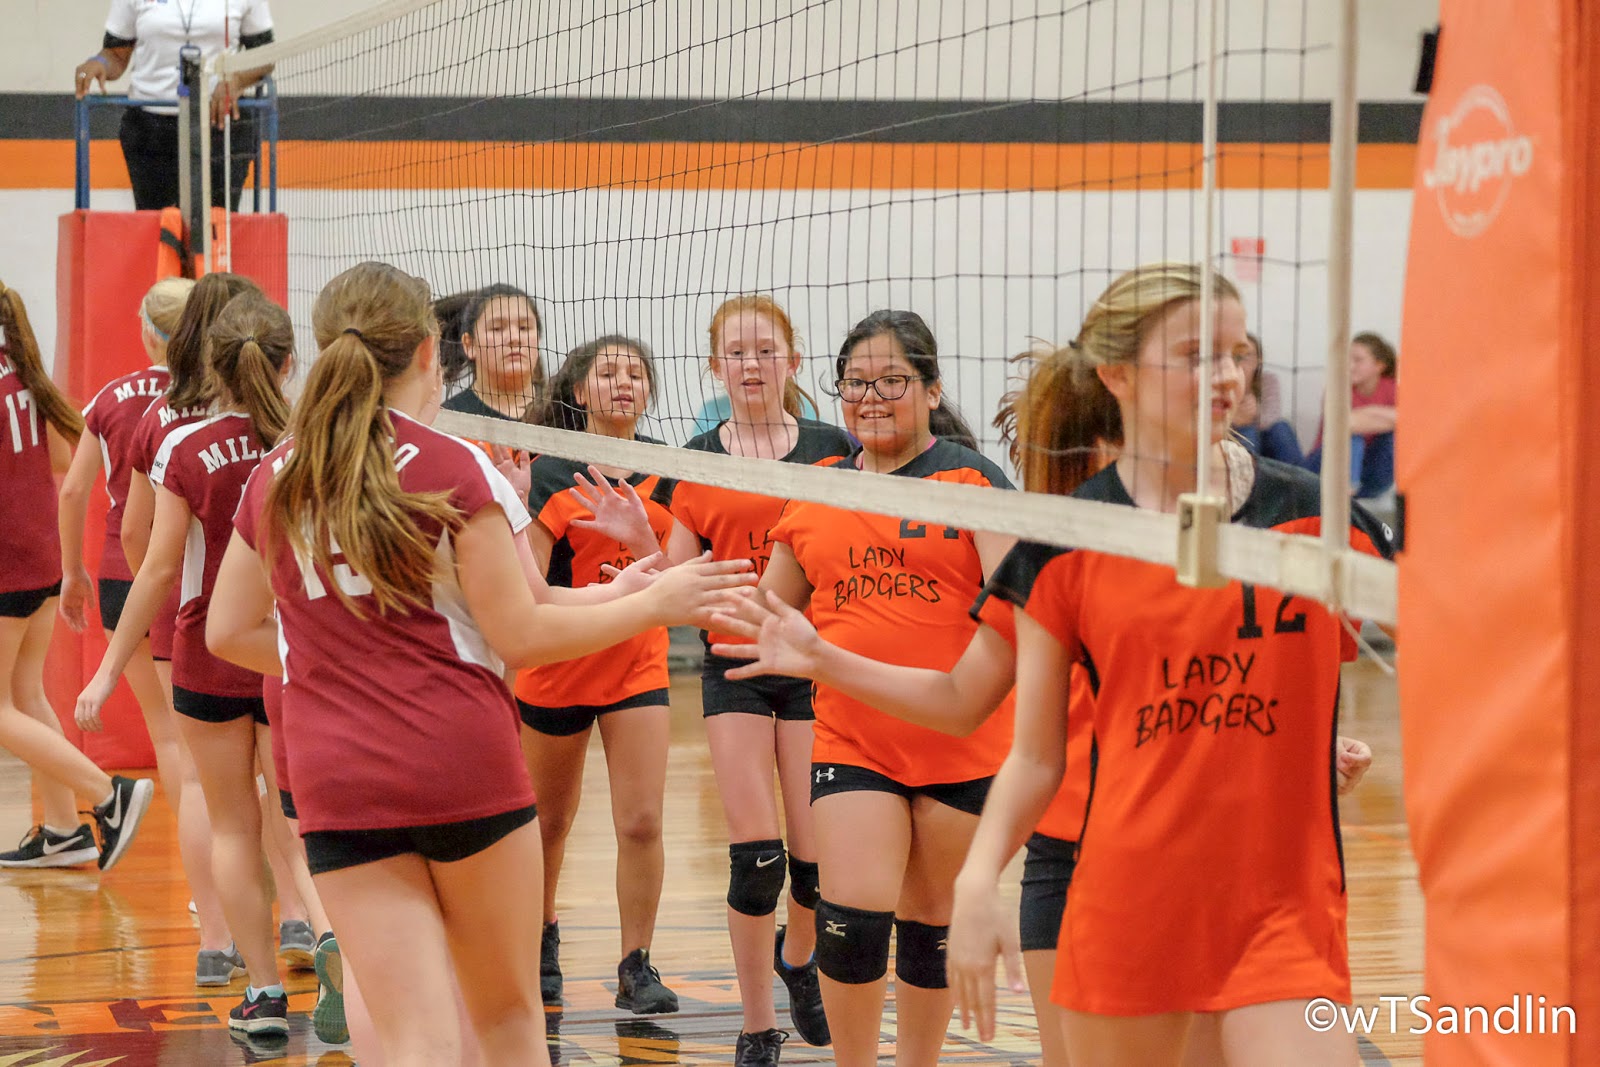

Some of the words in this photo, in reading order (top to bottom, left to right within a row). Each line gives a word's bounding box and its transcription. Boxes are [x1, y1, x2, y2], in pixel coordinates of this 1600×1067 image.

[5, 389, 39, 454] 17
[197, 435, 265, 475] MIL
[849, 545, 906, 569] LADY
[833, 572, 941, 612] BADGERS
[1236, 582, 1307, 640] 12
[1162, 652, 1258, 691] LADY
[1135, 693, 1280, 749] BADGERS
